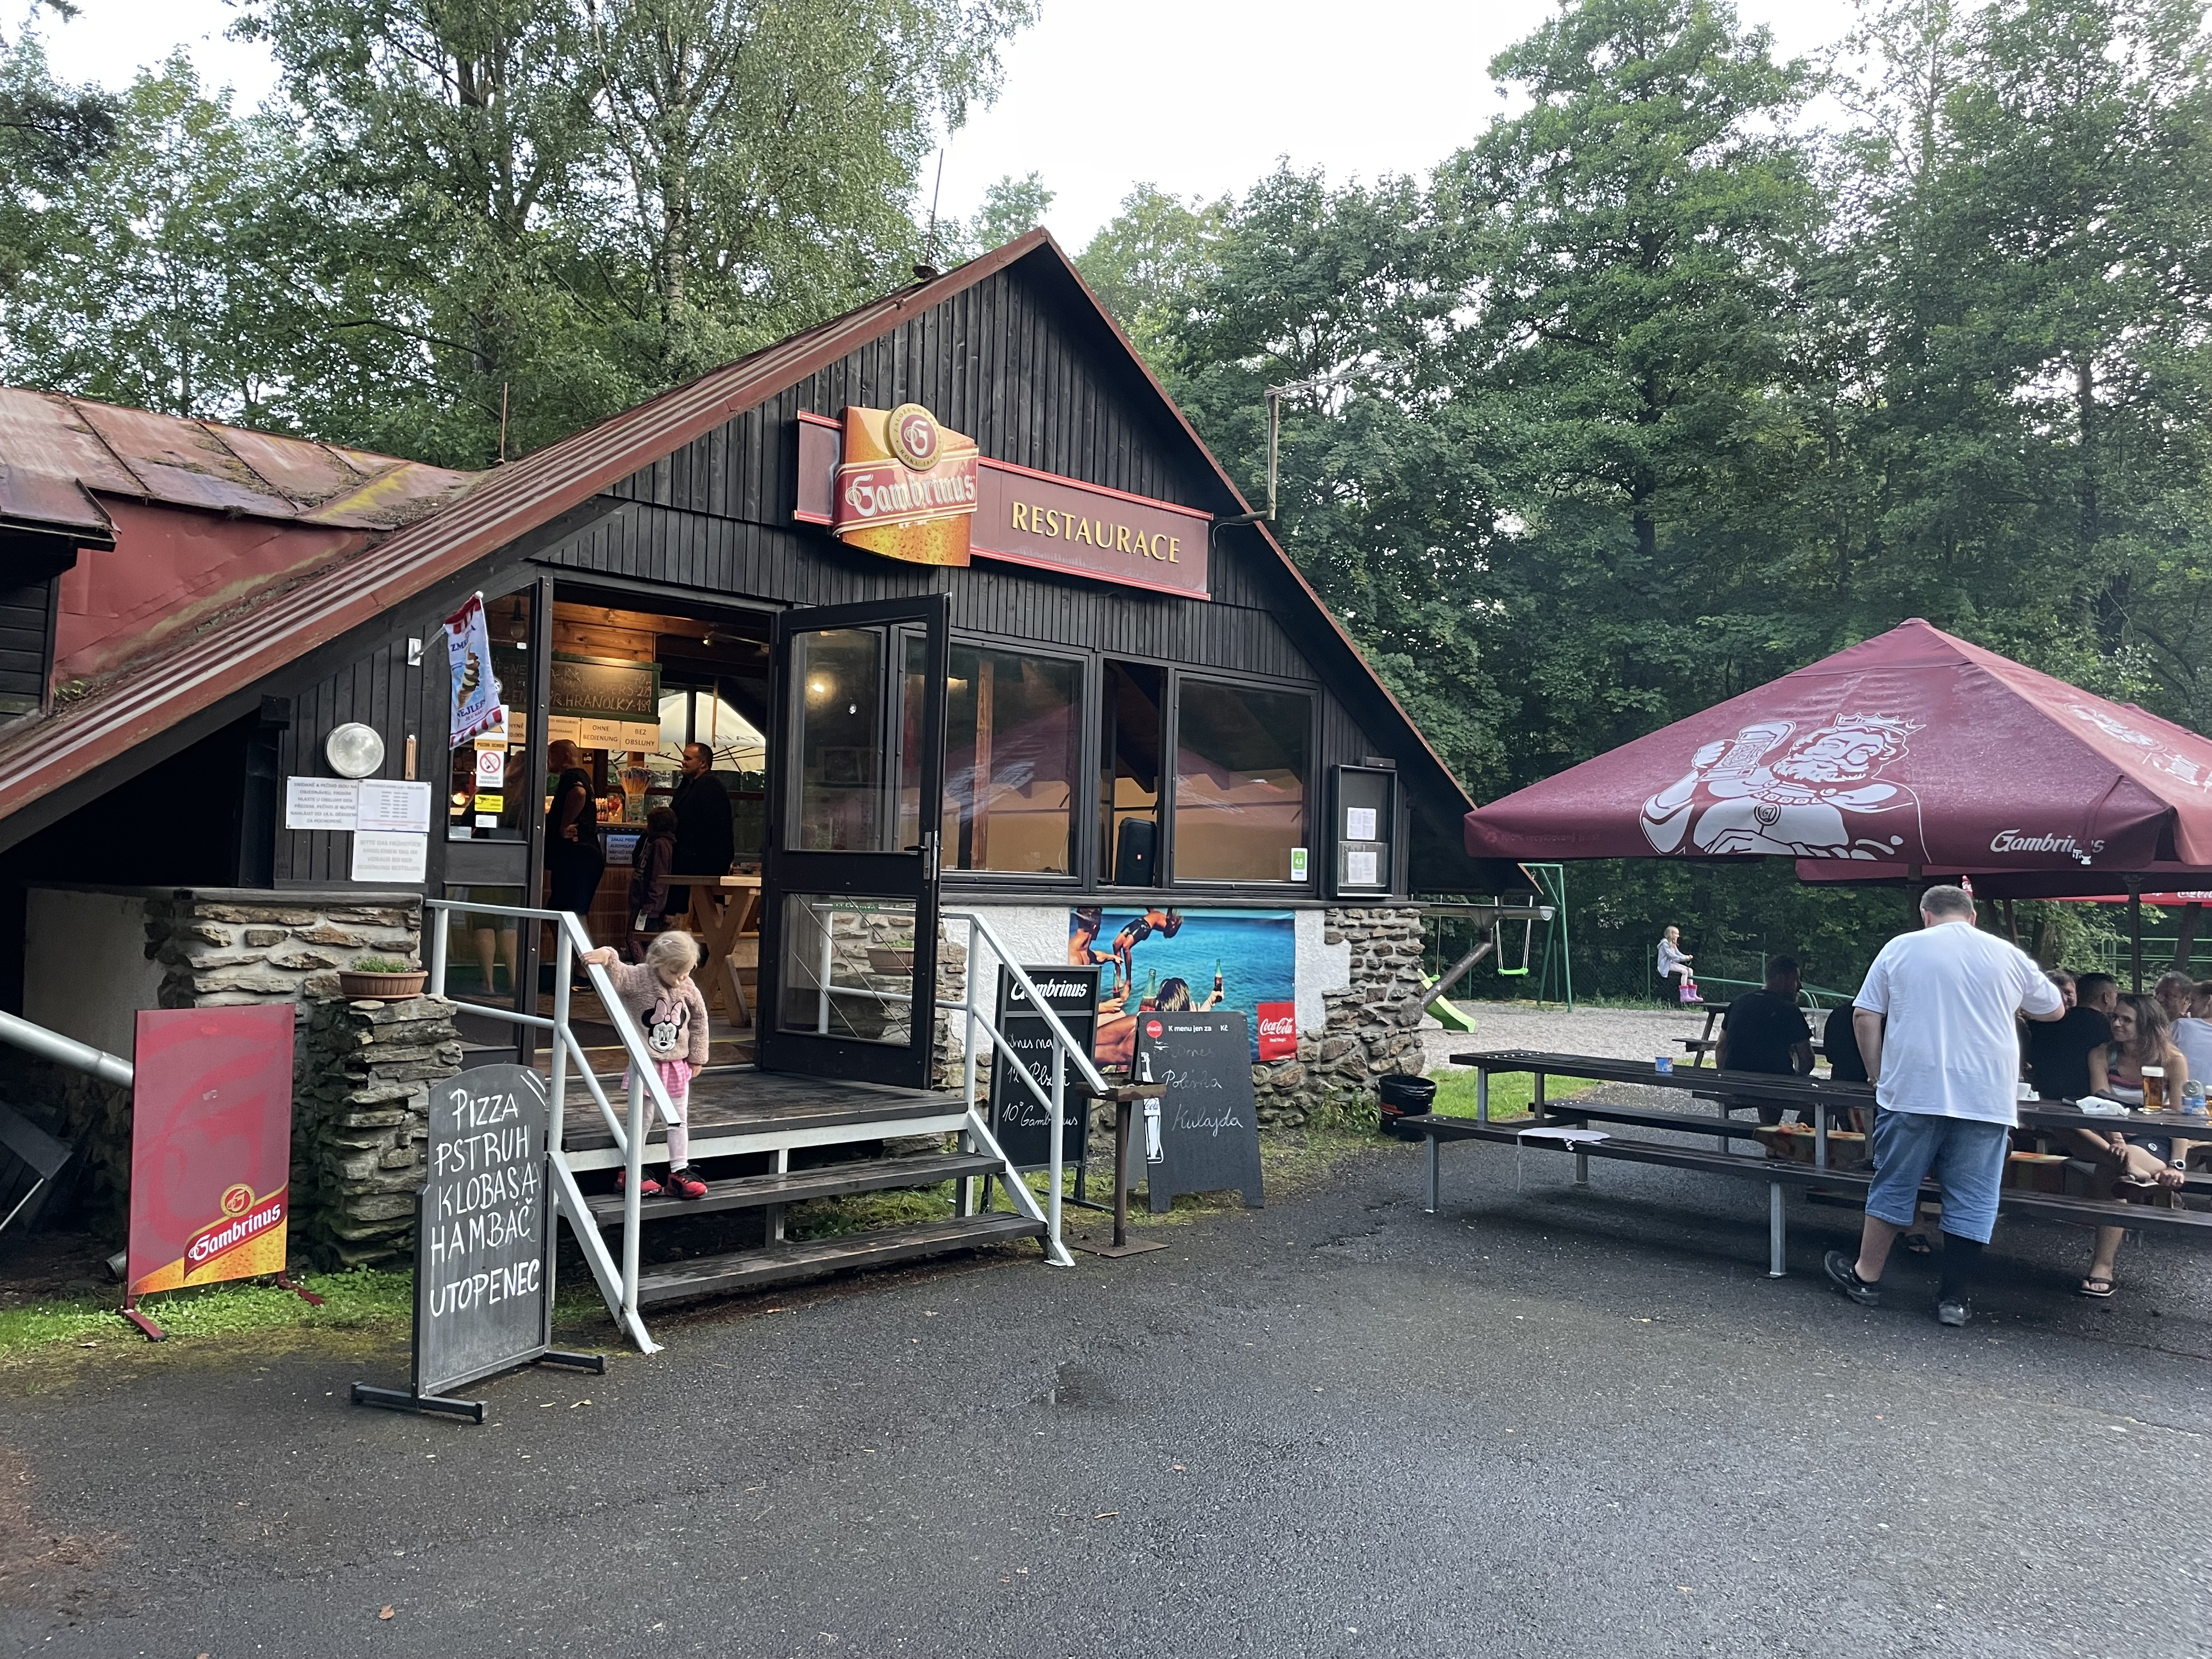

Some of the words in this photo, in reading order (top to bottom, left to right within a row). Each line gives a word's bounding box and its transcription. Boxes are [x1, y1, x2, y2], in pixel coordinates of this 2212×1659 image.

[845, 472, 977, 517] Gambrinus
[1012, 501, 1180, 564] RESTAURACE
[583, 734, 618, 742] BEDIENUNG
[1990, 829, 2106, 854] Gambris
[1011, 976, 1088, 1001] Gmbrinus
[1260, 1018, 1294, 1036] Coca-Cola
[1172, 1104, 1244, 1137] Kulajda
[435, 1125, 529, 1176] PSTRUH
[439, 1162, 537, 1221] KLOBASA
[188, 1204, 281, 1261] Gambrinus
[430, 1259, 539, 1317] UTOPENEC
